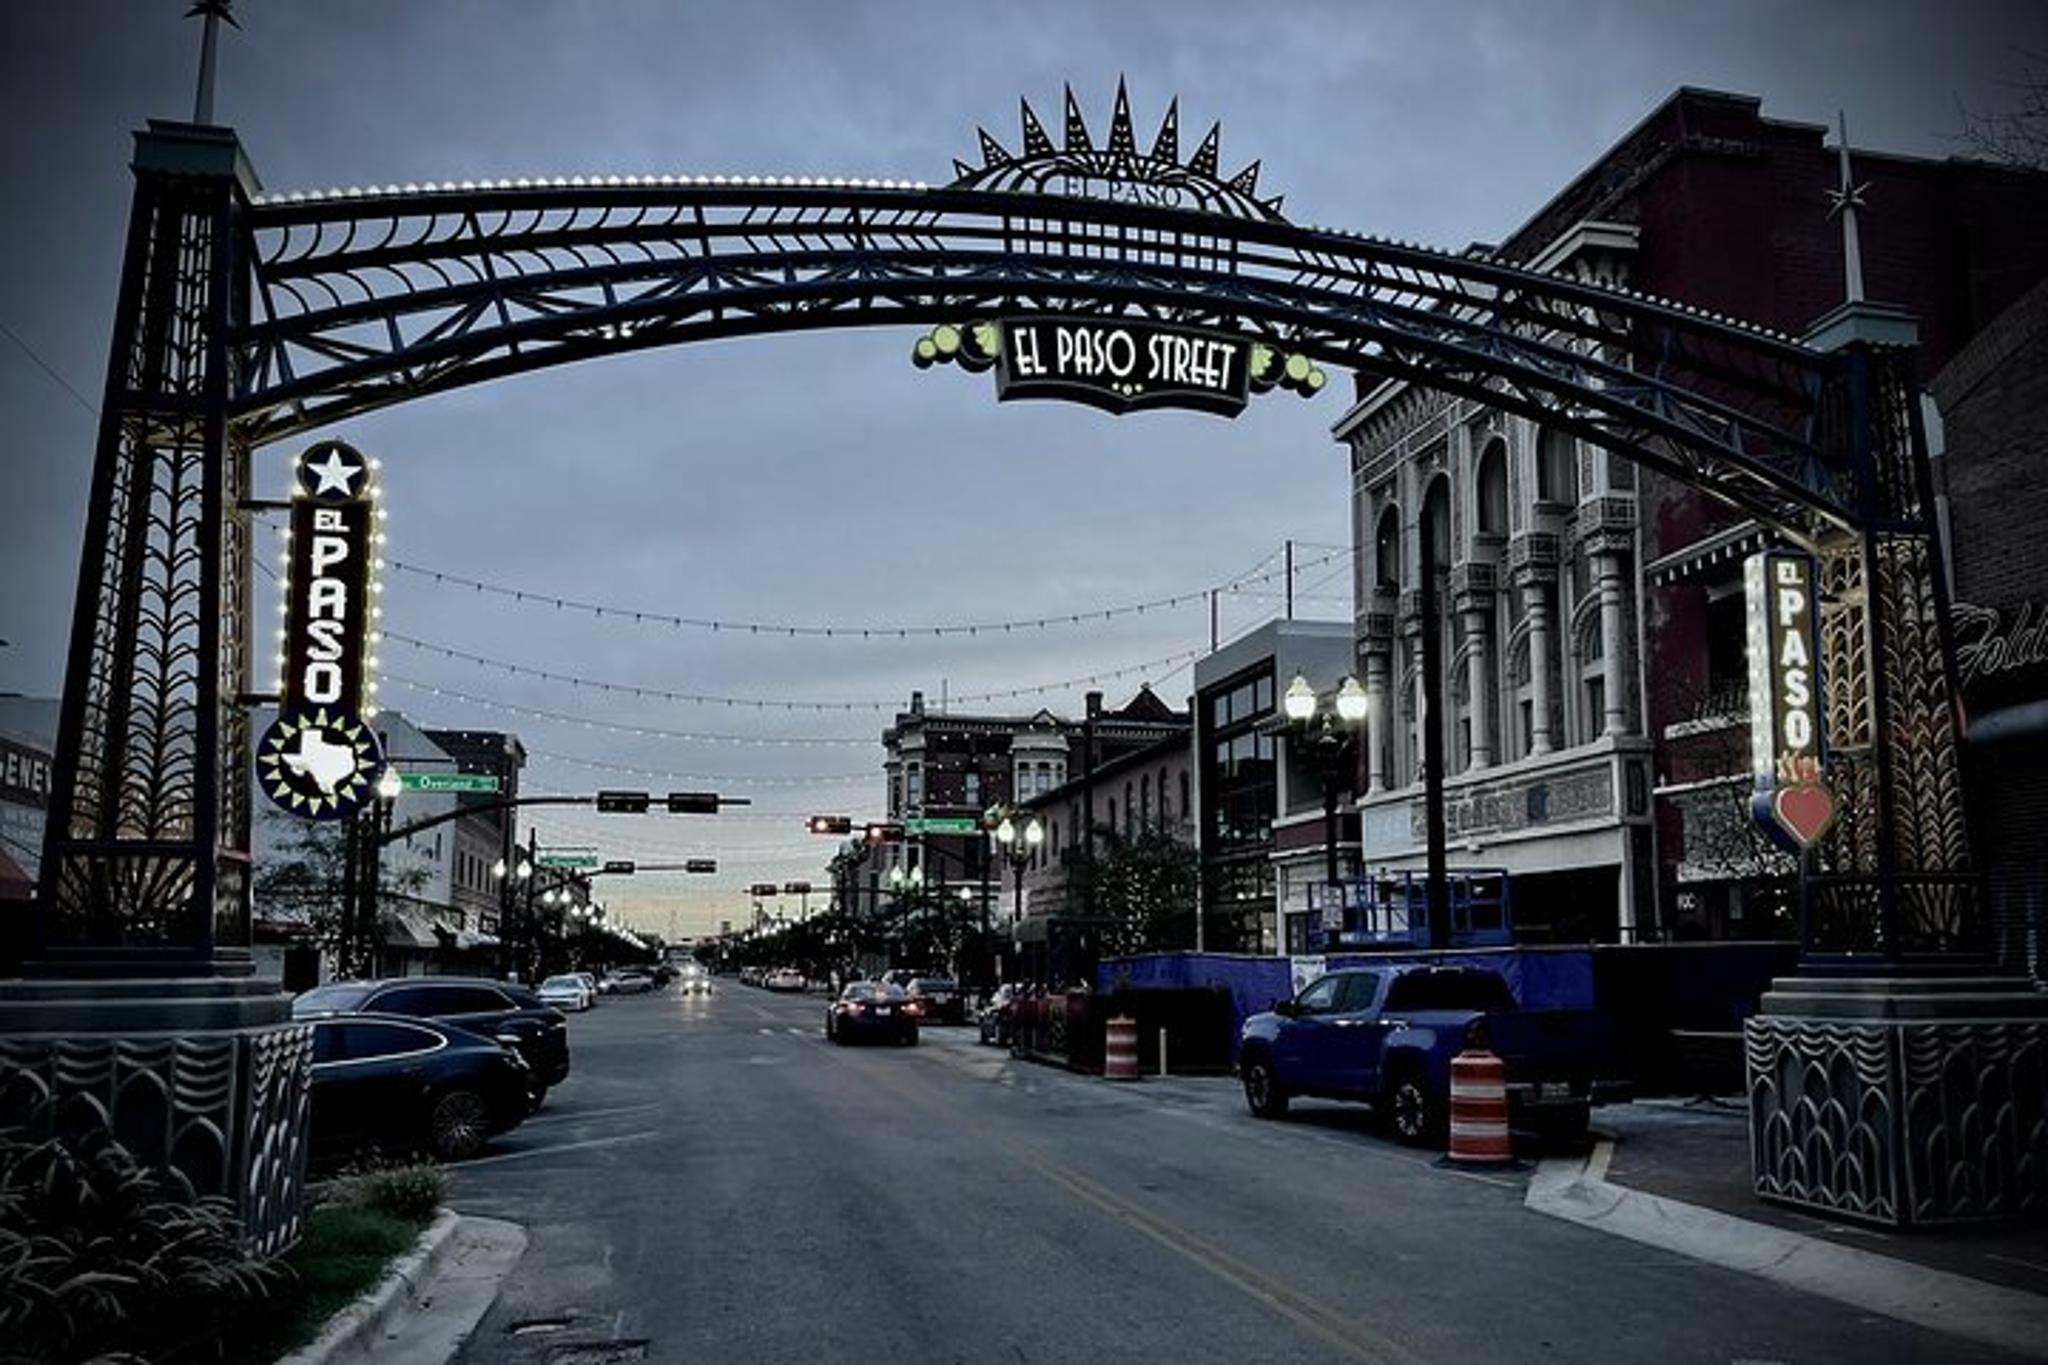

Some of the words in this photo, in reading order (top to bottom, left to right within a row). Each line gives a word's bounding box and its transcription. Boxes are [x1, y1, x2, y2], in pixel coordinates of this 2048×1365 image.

[1063, 176, 1099, 199] EL
[1108, 180, 1181, 209] PASO
[1013, 327, 1048, 375] EL
[1056, 327, 1136, 377] PASO
[1148, 333, 1237, 390] STREET
[313, 508, 350, 533] EL
[1776, 561, 1804, 585] EL
[303, 535, 349, 703] PASO
[1779, 588, 1812, 748] PASO
